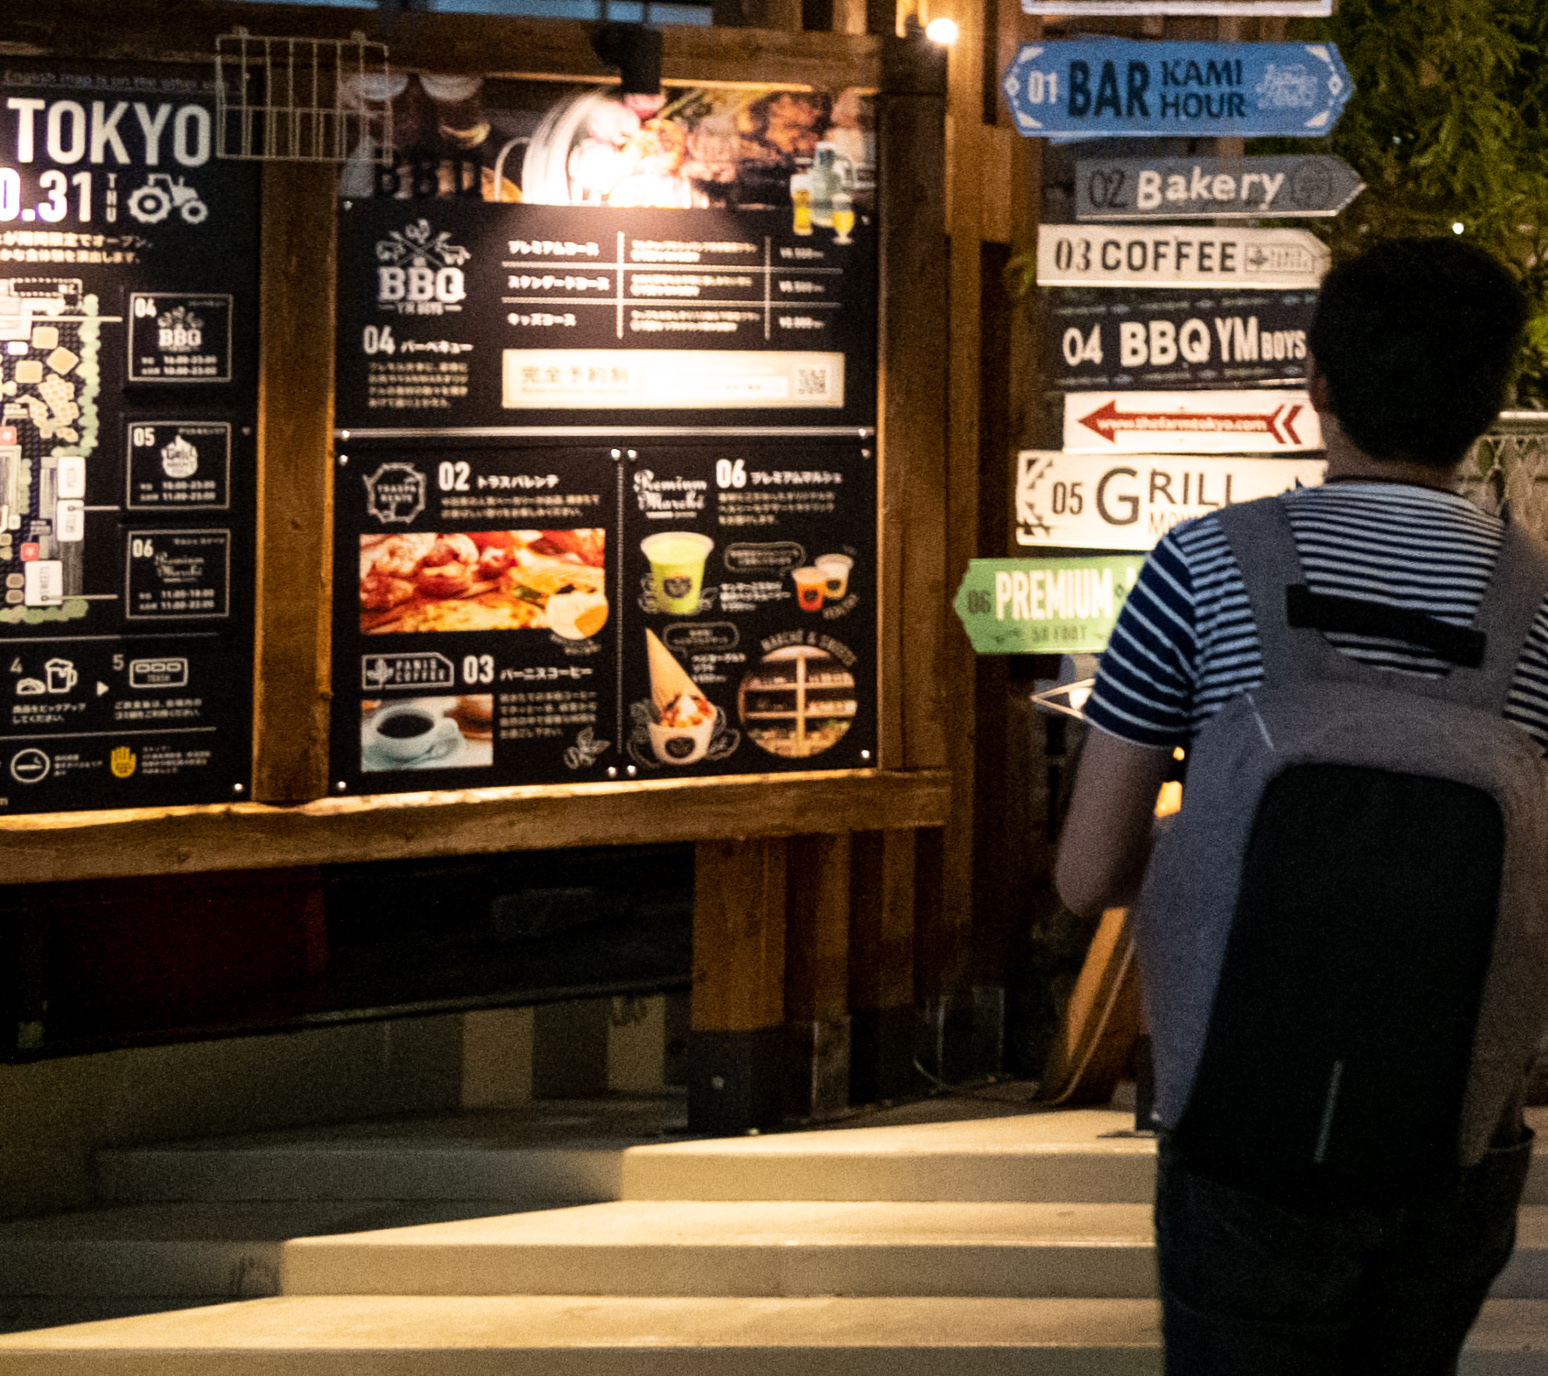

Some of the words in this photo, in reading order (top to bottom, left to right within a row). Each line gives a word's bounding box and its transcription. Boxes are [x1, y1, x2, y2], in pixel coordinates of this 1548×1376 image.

[1027, 70, 1059, 105] 01
[1067, 59, 1150, 119] BAR
[1160, 59, 1244, 87] KAMI
[1160, 90, 1247, 119] HOUR
[7, 98, 210, 167] TOKYO
[1088, 167, 1129, 209] 02
[1136, 166, 1286, 211] Bakery
[1055, 238, 1092, 272] 03
[1101, 239, 1237, 273] COFFEE
[377, 266, 467, 303] BBQ
[135, 298, 157, 318] 04
[159, 328, 202, 347] BBQ
[363, 325, 396, 355] 04
[1063, 324, 1103, 366] 04
[1119, 318, 1212, 367] BBQ
[133, 427, 155, 447] 05
[438, 461, 471, 492] 02
[715, 458, 747, 489] 06
[1052, 481, 1083, 515] 05
[1095, 467, 1236, 527] GRILL
[132, 539, 153, 558] 06
[995, 568, 1114, 622] PREMIUM
[10, 657, 23, 674] 4
[112, 654, 125, 671] 5
[462, 654, 495, 685] 03
